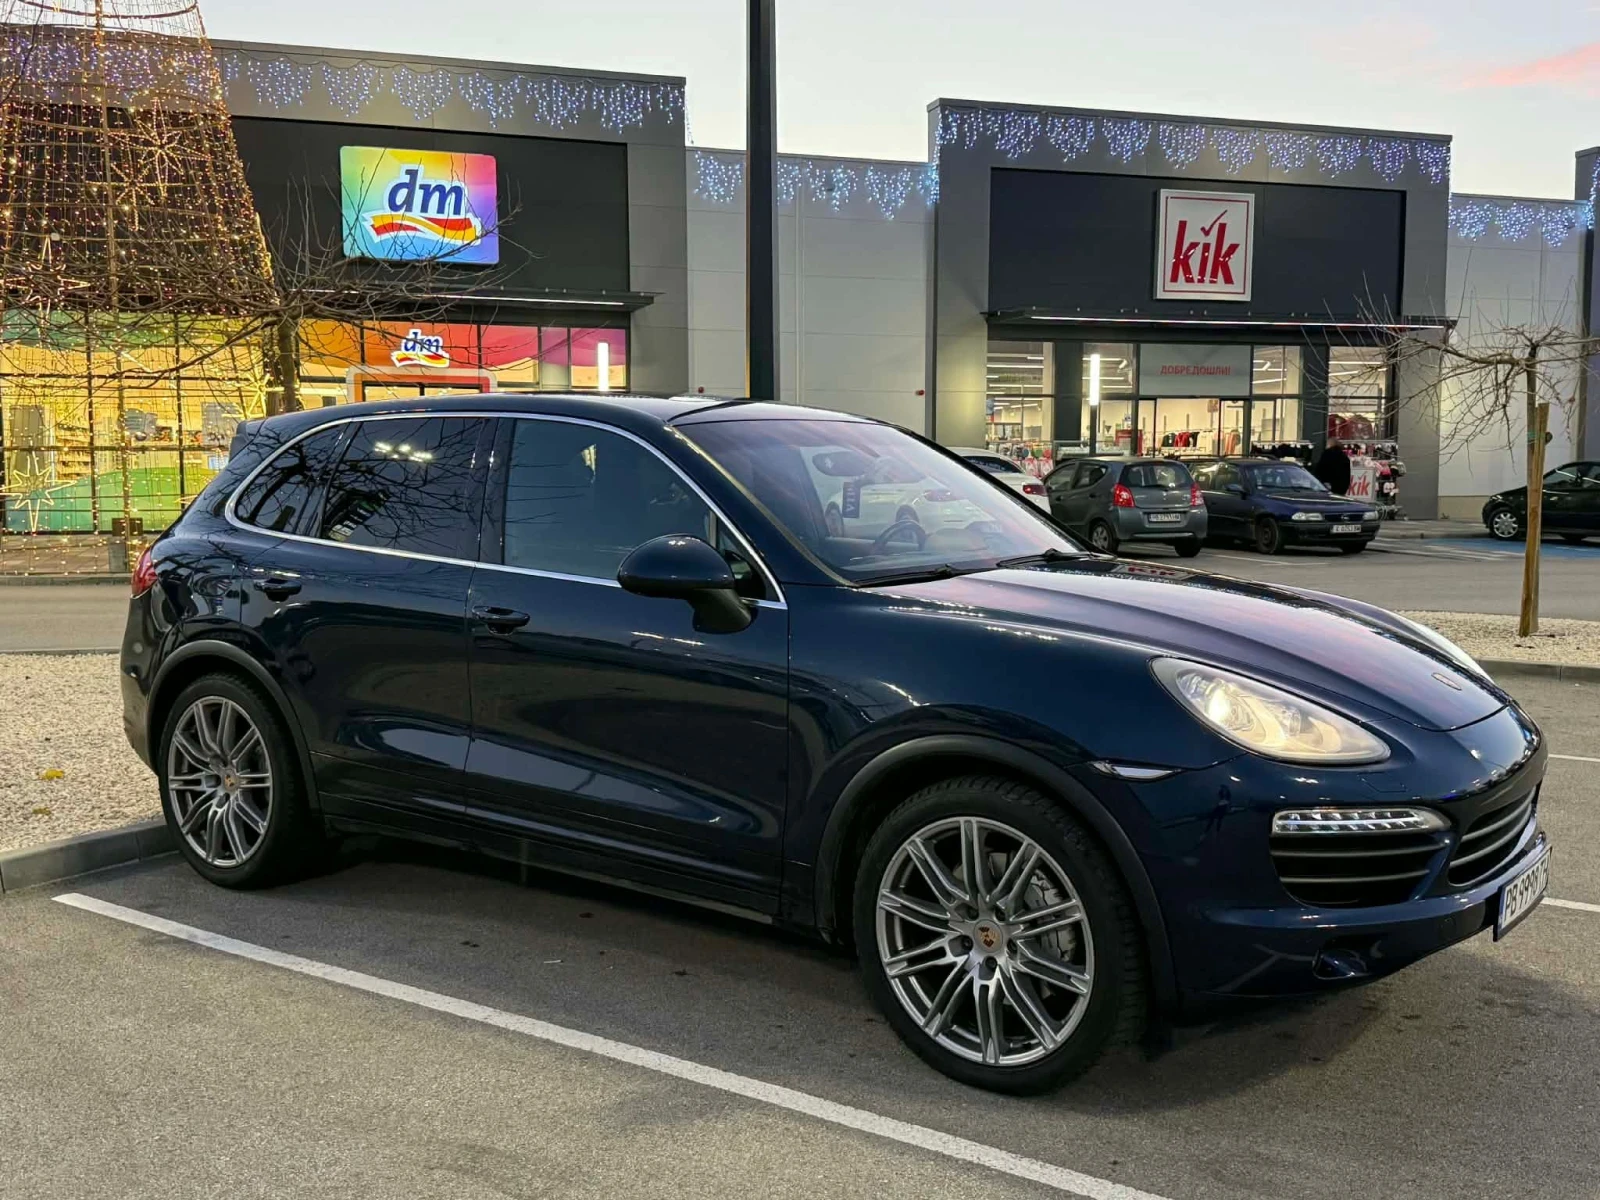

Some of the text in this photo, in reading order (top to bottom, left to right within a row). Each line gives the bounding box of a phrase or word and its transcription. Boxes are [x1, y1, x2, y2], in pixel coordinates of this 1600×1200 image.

[388, 169, 463, 215] dm
[1170, 209, 1240, 285] kik
[404, 332, 440, 352] dm
[1347, 470, 1370, 496] kik
